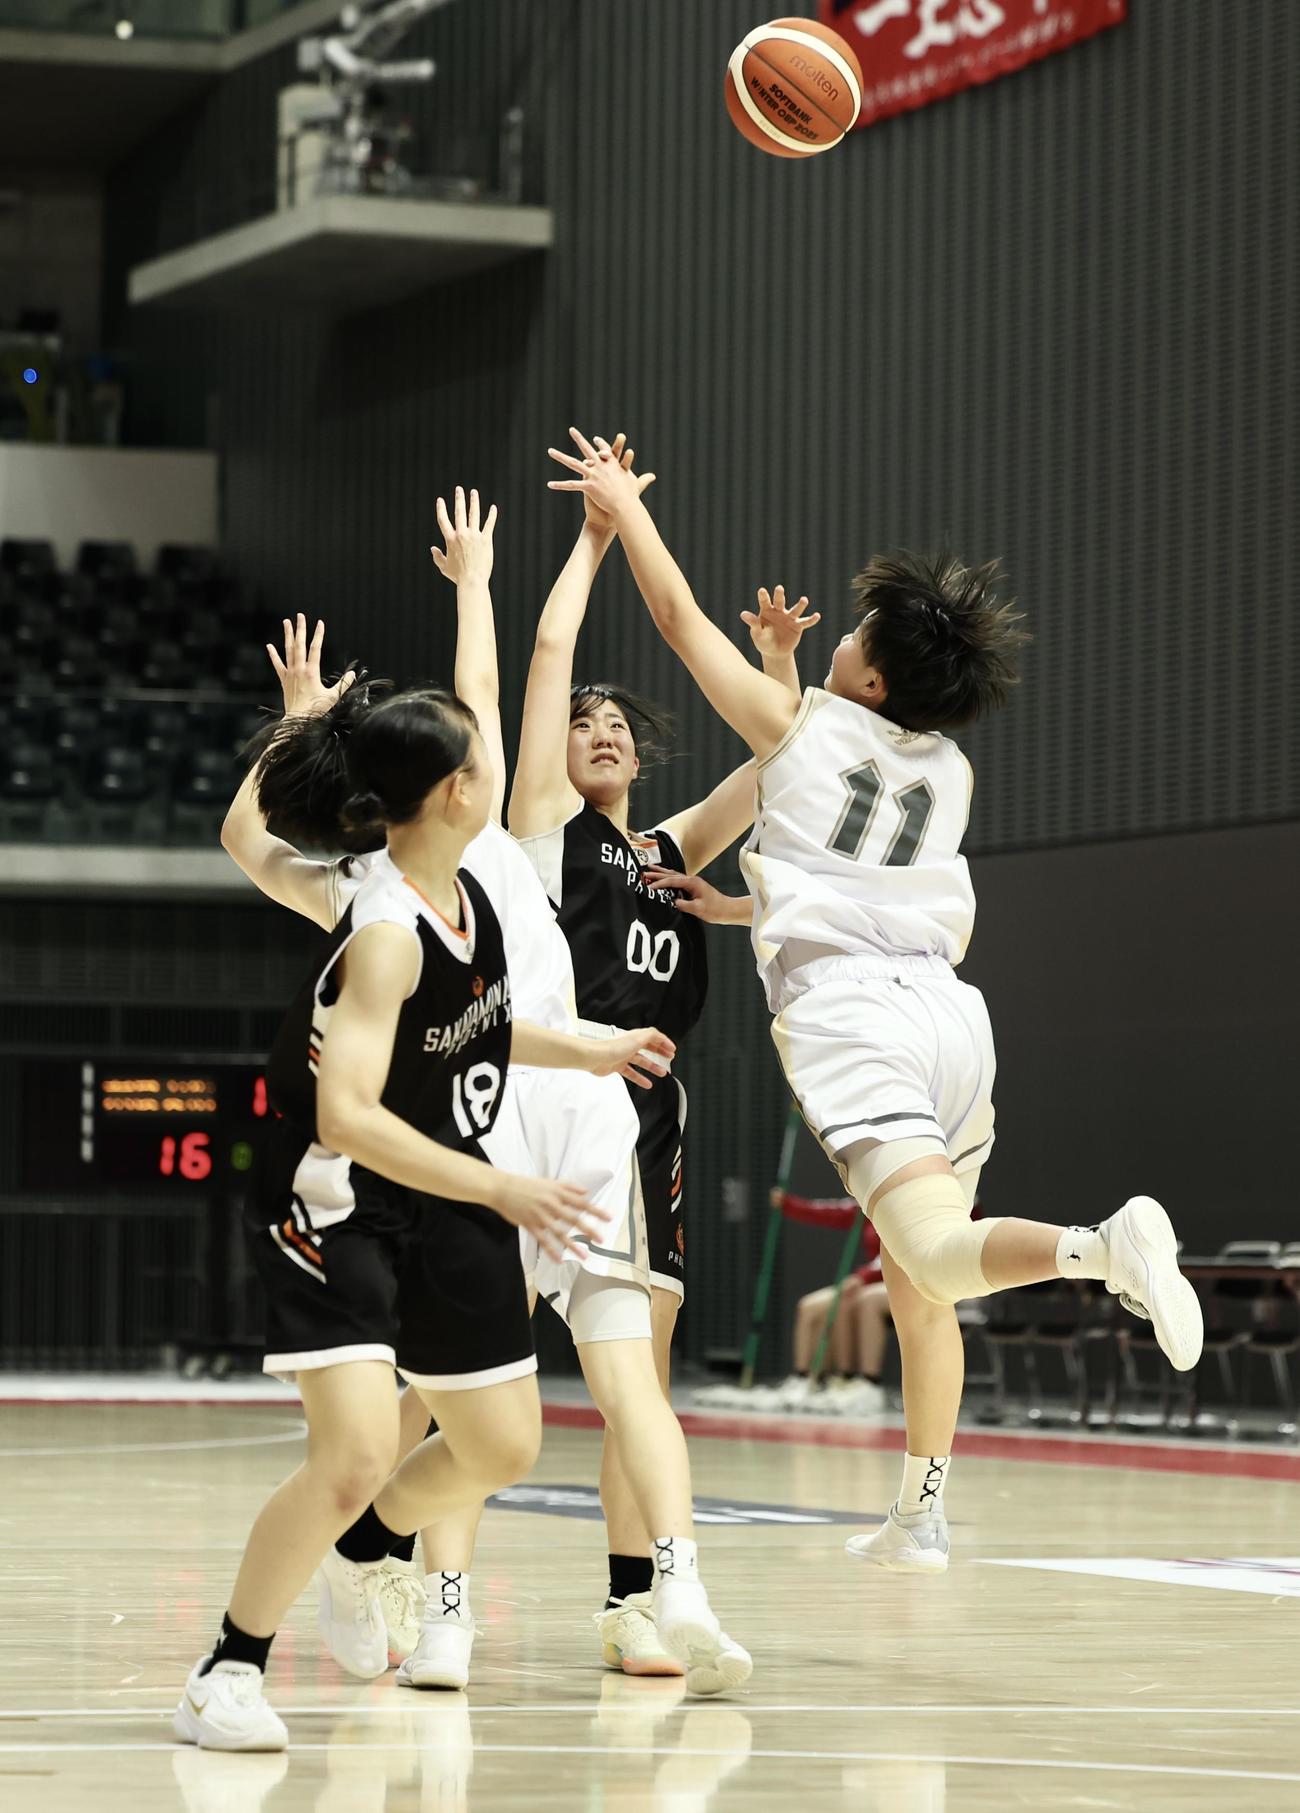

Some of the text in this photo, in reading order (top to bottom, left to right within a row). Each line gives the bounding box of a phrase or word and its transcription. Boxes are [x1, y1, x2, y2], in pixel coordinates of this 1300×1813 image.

[751, 77, 779, 111] WINTER
[777, 109, 798, 125] CUP
[789, 55, 839, 102] molten
[769, 83, 813, 124] SOFTBANK
[824, 758, 937, 866] 11
[626, 918, 680, 983] 00
[159, 1132, 212, 1180] 16
